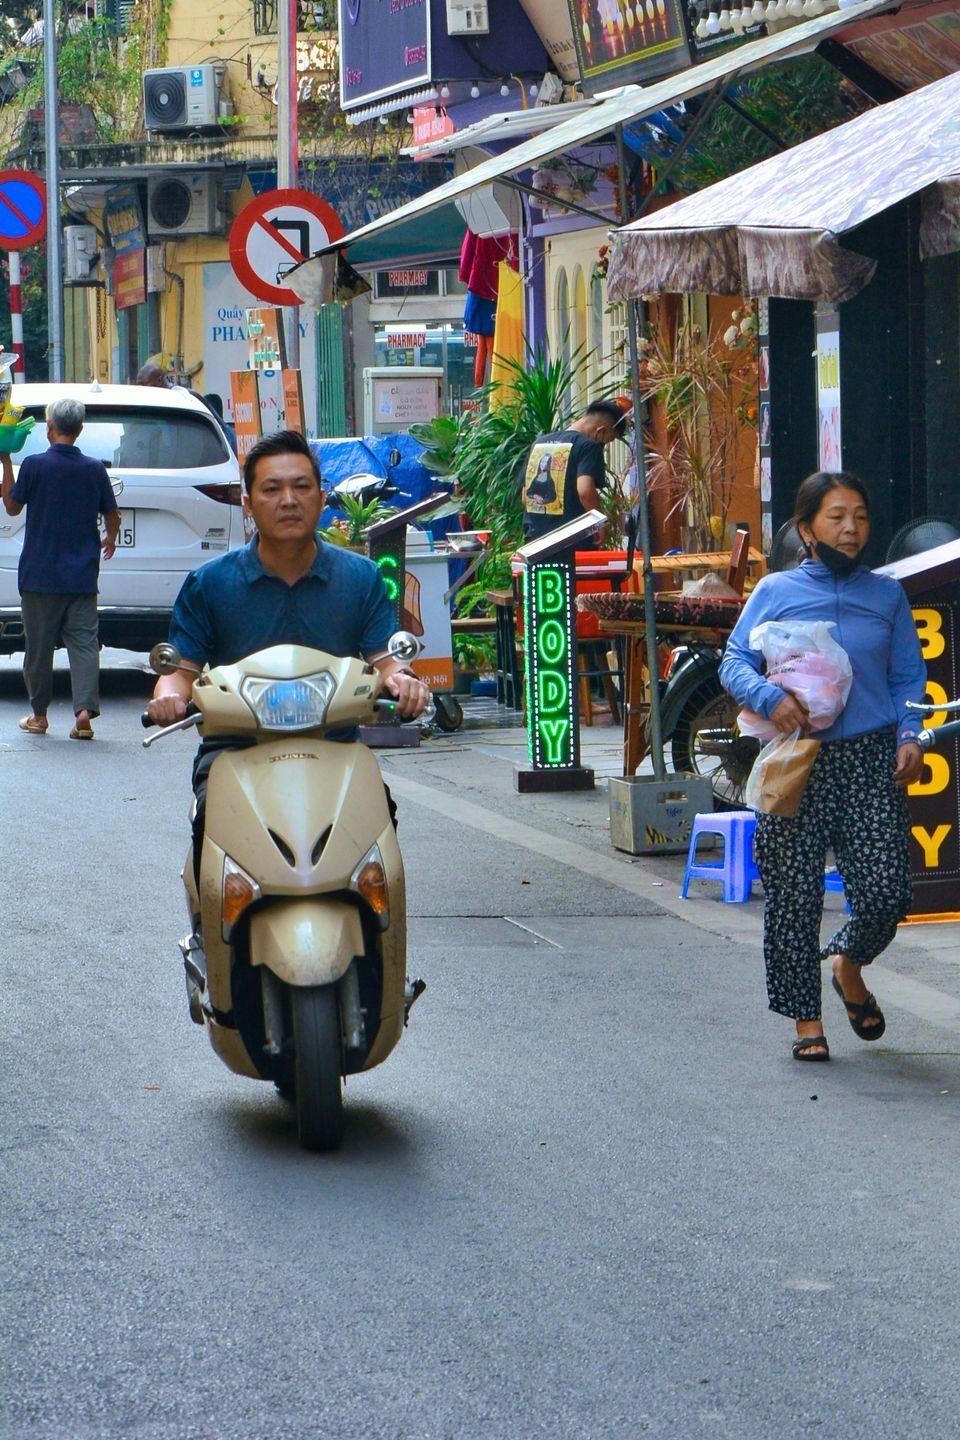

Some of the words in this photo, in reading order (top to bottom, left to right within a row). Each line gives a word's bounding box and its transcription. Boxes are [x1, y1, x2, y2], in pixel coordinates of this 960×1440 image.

[389, 271, 429, 287] PHARMACY
[387, 333, 426, 349] PHARMACY
[464, 332, 479, 348] PHA
[537, 569, 568, 764] BODY
